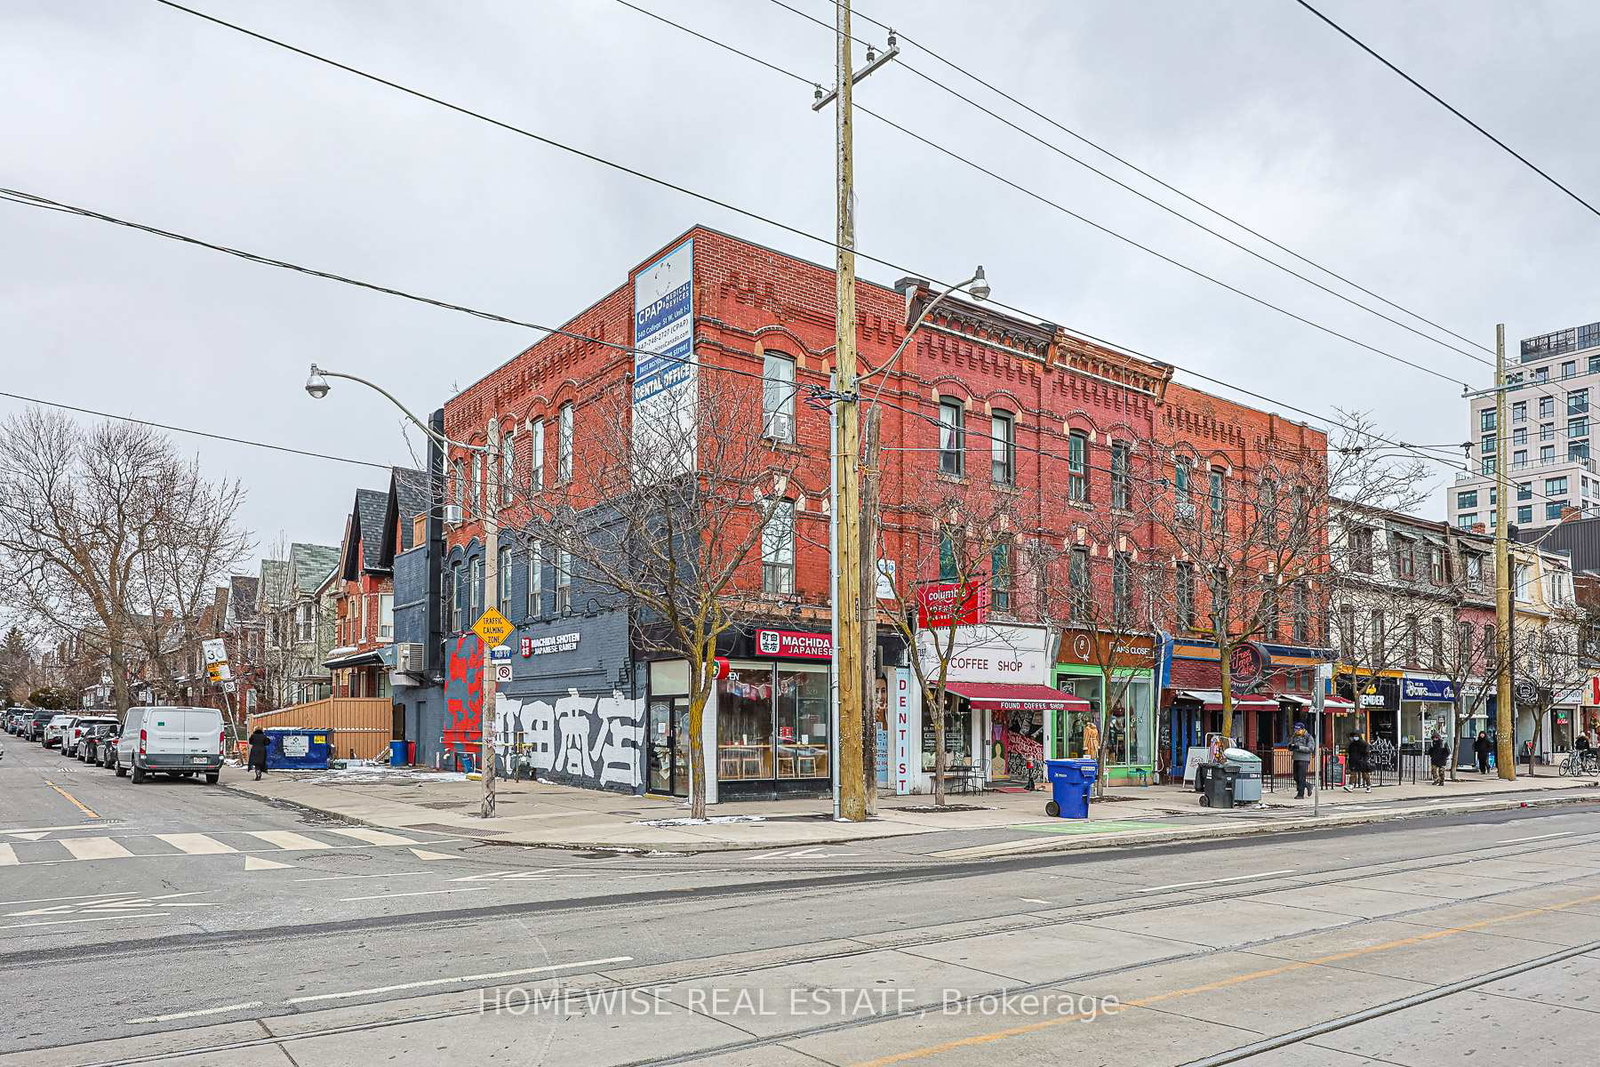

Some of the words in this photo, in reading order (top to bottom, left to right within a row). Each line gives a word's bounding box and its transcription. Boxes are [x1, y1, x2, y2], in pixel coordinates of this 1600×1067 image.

[665, 283, 690, 302] MEDICAL
[665, 290, 690, 309] DEVICES
[638, 300, 663, 325] CPAP
[663, 364, 690, 387] OFFICE
[483, 617, 502, 625] TRAFFIC
[531, 637, 556, 648] MACHIDA
[556, 632, 580, 643] SHOTEN
[782, 636, 831, 648] MACHIDA
[533, 642, 559, 655] JAPANESE
[559, 642, 577, 652] RAMEN
[788, 646, 833, 656] JAPANESE
[950, 657, 989, 670] COFFEE
[998, 660, 1023, 672] SHOP
[899, 680, 907, 791] DENTIST
